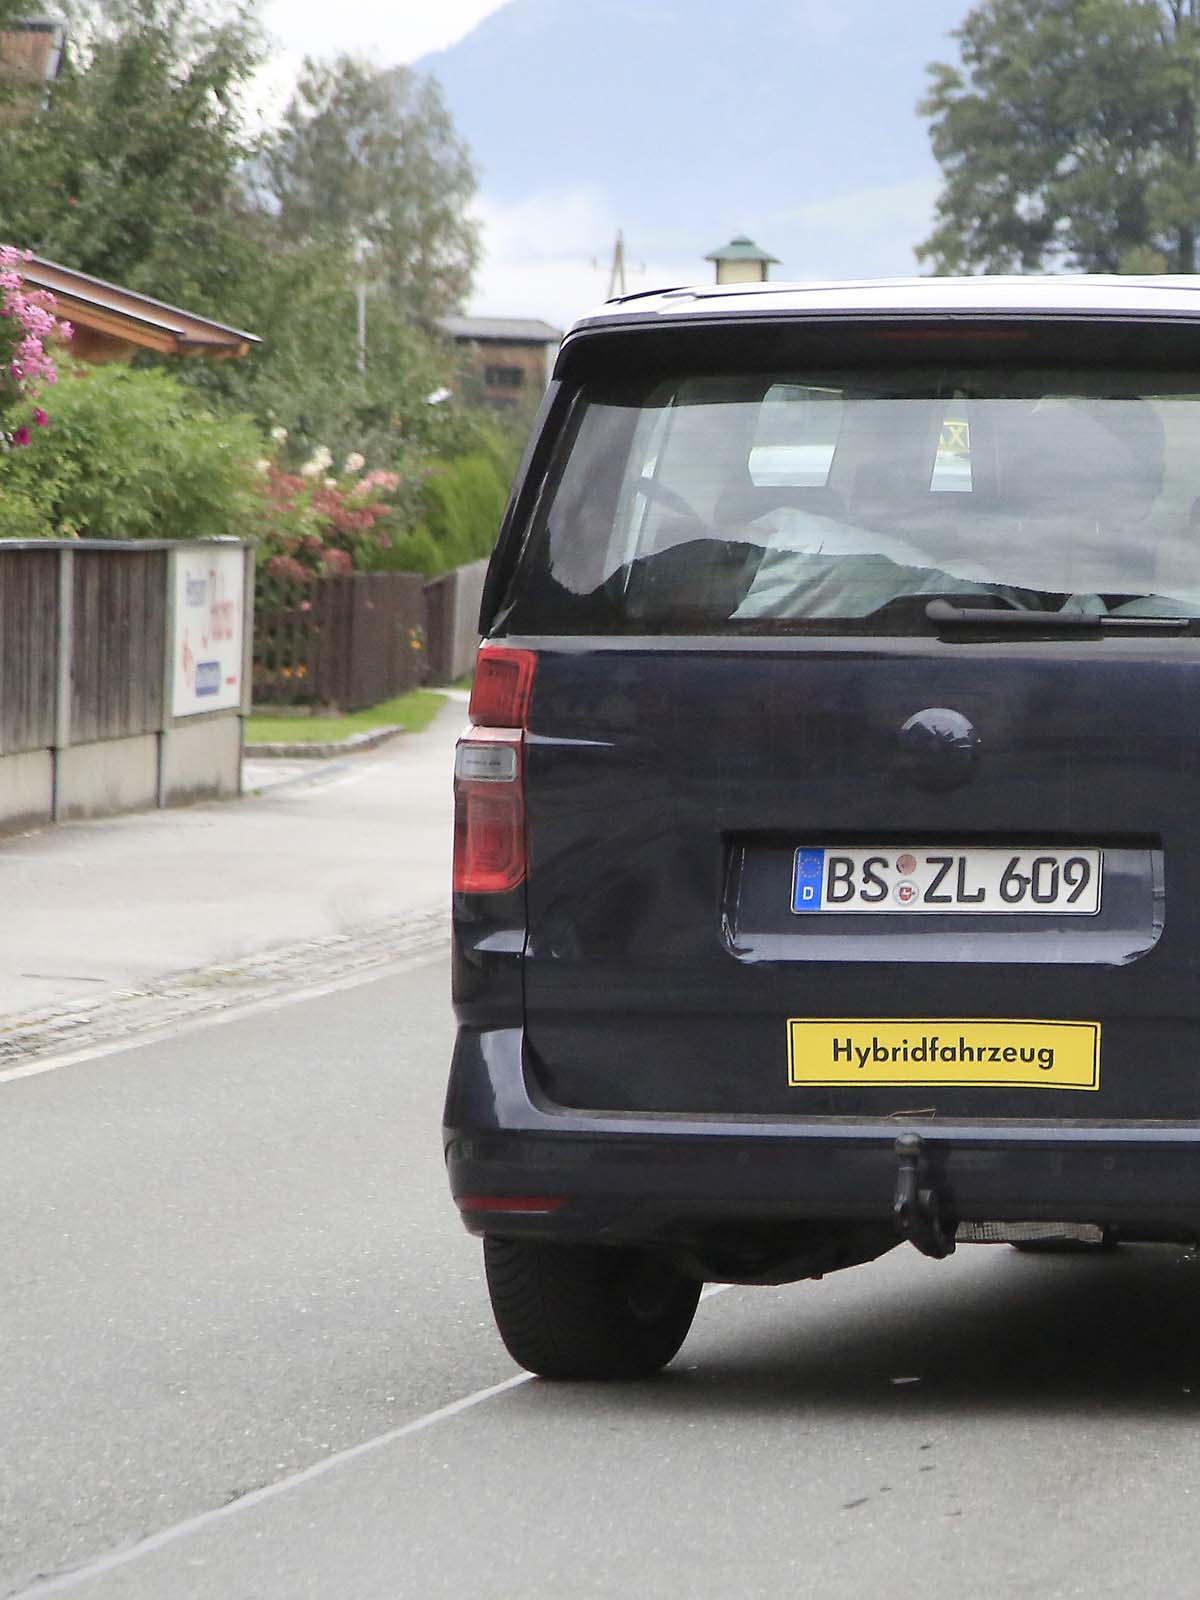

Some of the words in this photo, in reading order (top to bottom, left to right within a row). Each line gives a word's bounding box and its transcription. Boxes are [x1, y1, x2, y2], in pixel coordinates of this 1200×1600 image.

[802, 886, 815, 901] D
[826, 856, 890, 903] BS
[923, 856, 987, 904] ZL
[999, 856, 1092, 904] 609
[832, 1036, 1055, 1070] Hybridfahrzeug
